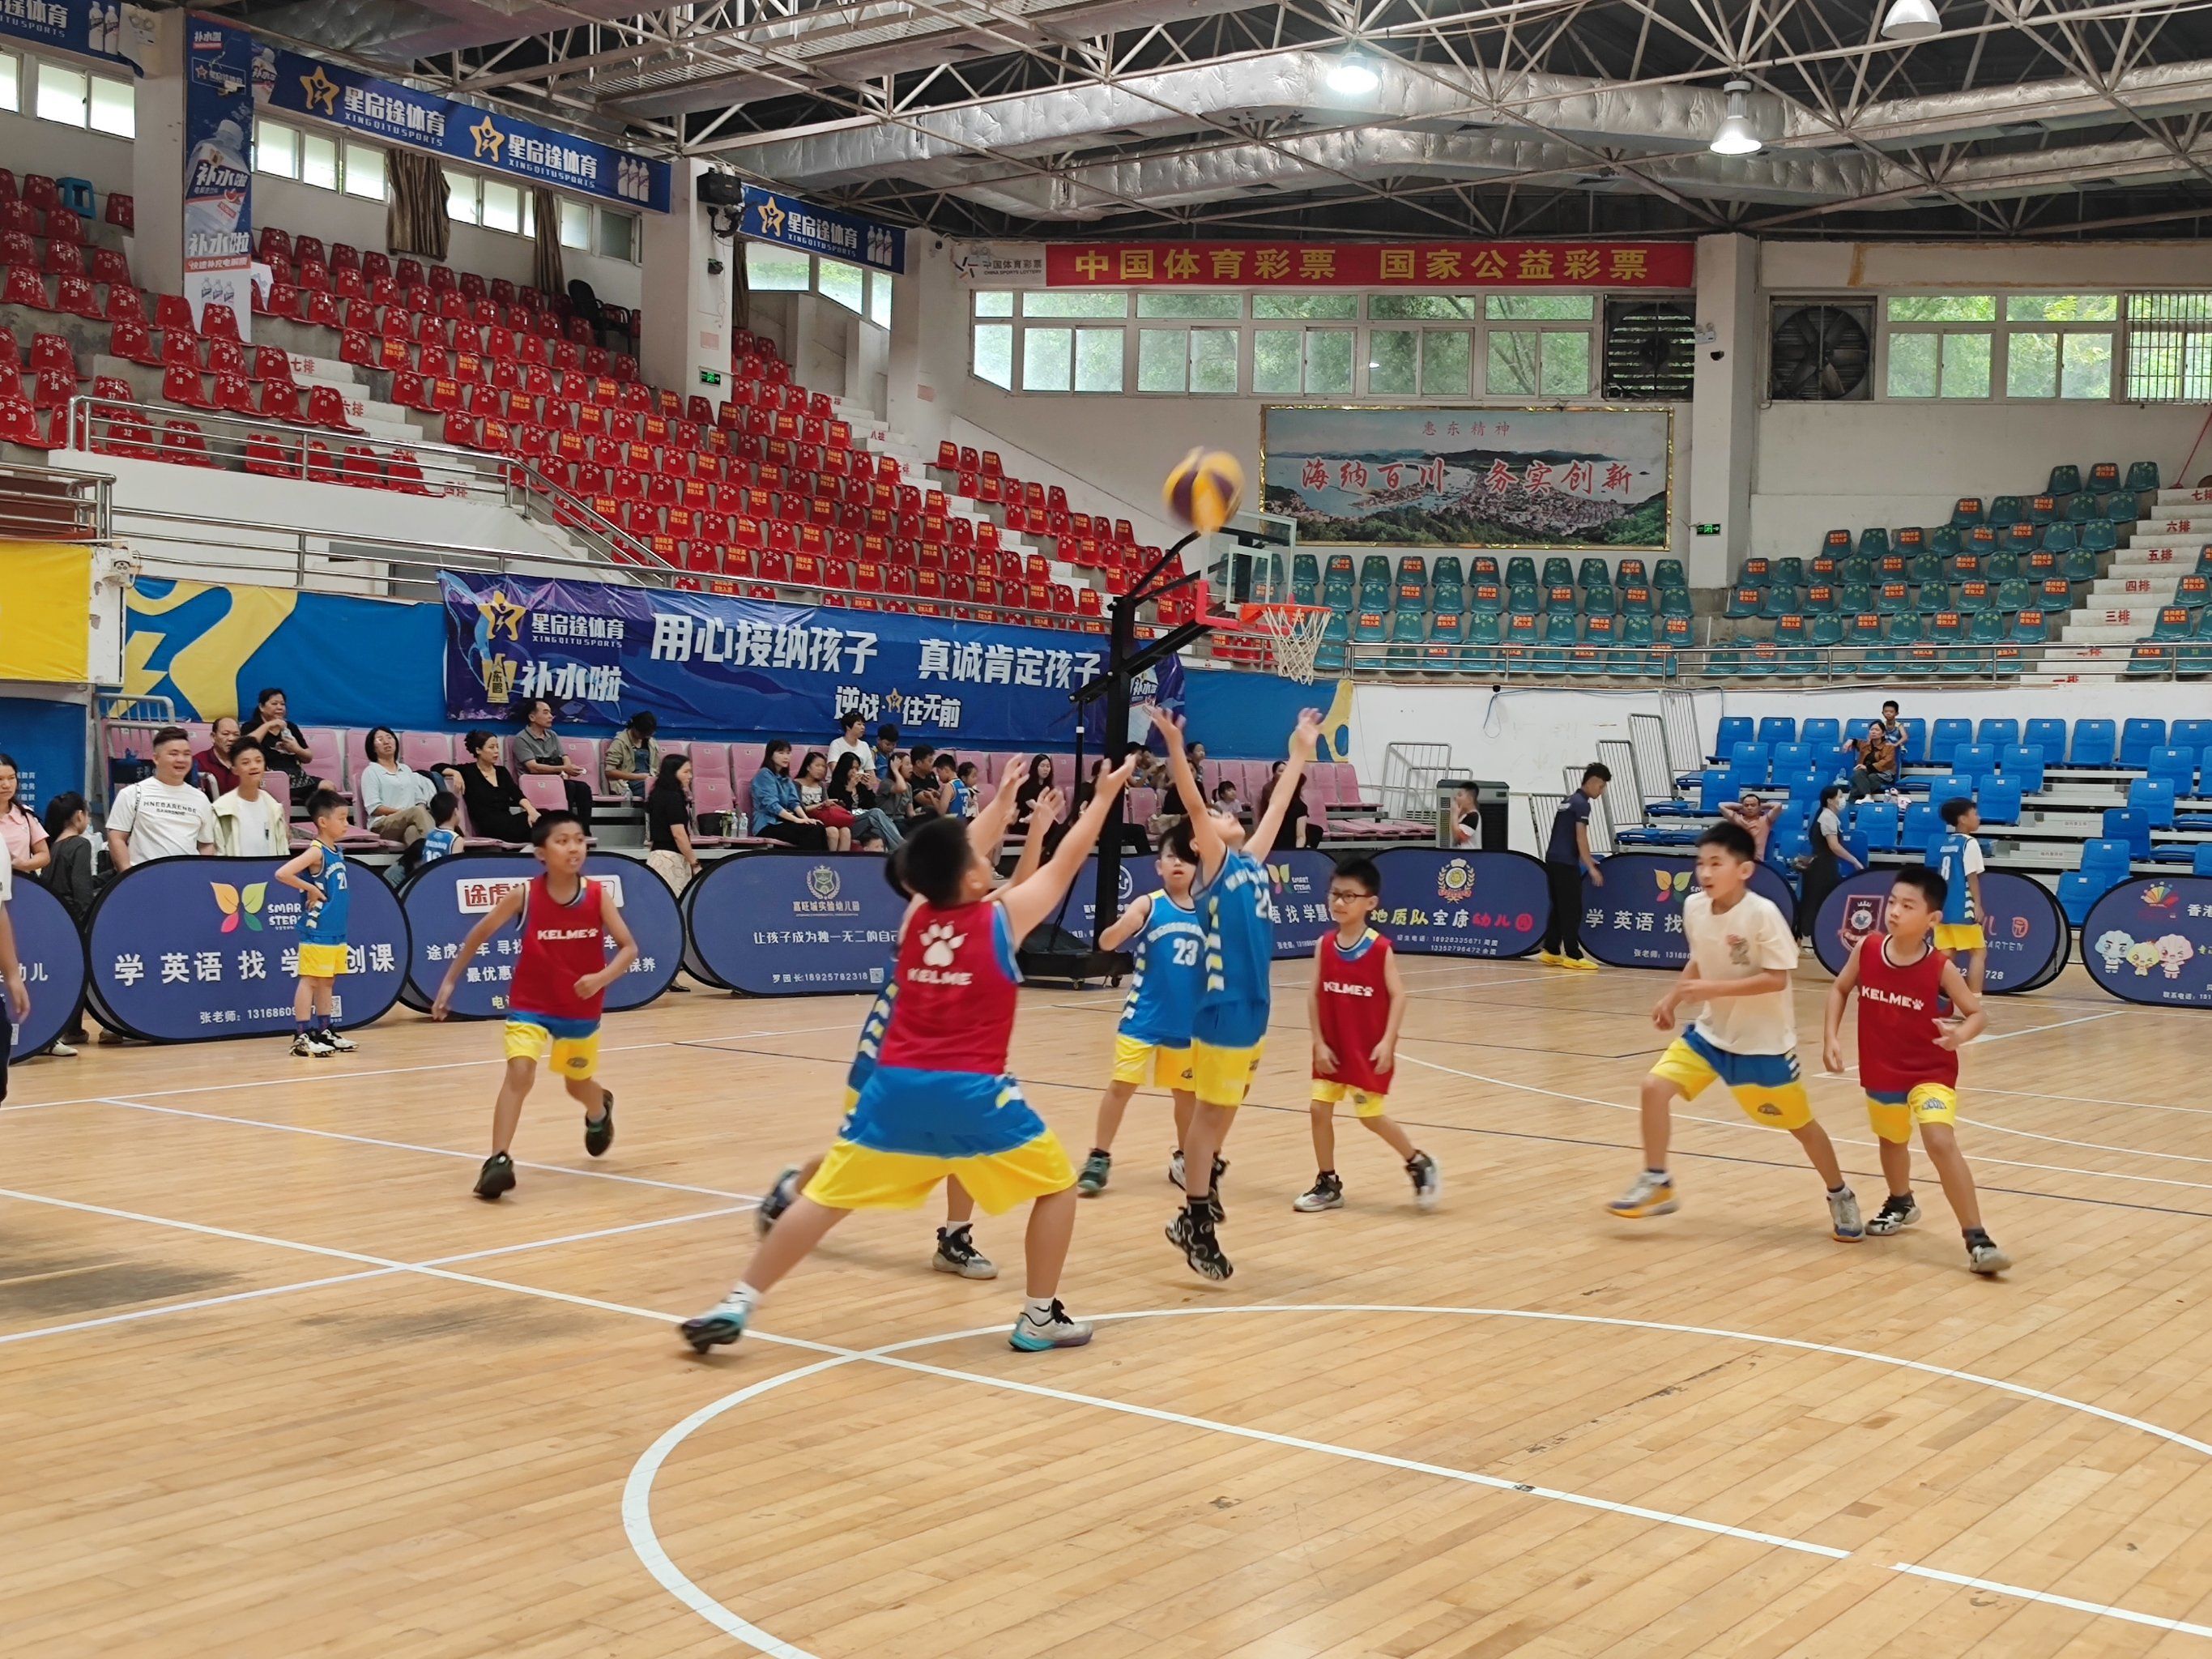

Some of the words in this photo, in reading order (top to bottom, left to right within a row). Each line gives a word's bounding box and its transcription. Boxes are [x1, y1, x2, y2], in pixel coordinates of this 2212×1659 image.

[0, 0, 68, 28] 途体育
[344, 86, 445, 138] 星启途体育
[509, 134, 597, 180] 星启途体育
[197, 163, 248, 188] 补水啦
[788, 211, 858, 249] 星启途体育
[189, 232, 249, 257] 补水啦
[982, 259, 1042, 269] 中国体育彩票
[1075, 248, 1336, 280] 中国体育彩票
[1380, 249, 1647, 280] 国家公益彩票
[1421, 420, 1511, 437] 惠东精神
[1301, 458, 1445, 495] 海纳百川
[1485, 459, 1633, 495] 务实创新
[2167, 519, 2190, 533] 六排
[2148, 549, 2172, 561] 五排
[2125, 580, 2150, 592] 四排
[531, 612, 624, 640] 星启途体育
[2105, 610, 2130, 622] 三排
[650, 612, 878, 675] 用心接纳孩子
[918, 638, 1102, 689] 真诚肯定孩子
[522, 660, 622, 702] 补水啦
[464, 883, 524, 907] 途虎
[267, 903, 302, 914] SMAR
[269, 916, 301, 925] STEA
[1285, 904, 1300, 923] 找
[1303, 903, 1336, 923] 学慧
[1585, 908, 1605, 928] 学
[1613, 911, 1655, 932] 英语
[1664, 914, 1684, 933] 找
[538, 928, 588, 940] KELME
[427, 941, 490, 961] 途虎车
[1173, 938, 1199, 966] 23
[115, 953, 144, 986] 学
[160, 951, 223, 983] 英语
[237, 949, 266, 980] 找
[281, 943, 395, 979] 学创课
[467, 965, 514, 983] 最优惠
[629, 957, 656, 972] 保养
[907, 967, 974, 985] KELME
[1861, 985, 1912, 1009] KELME
